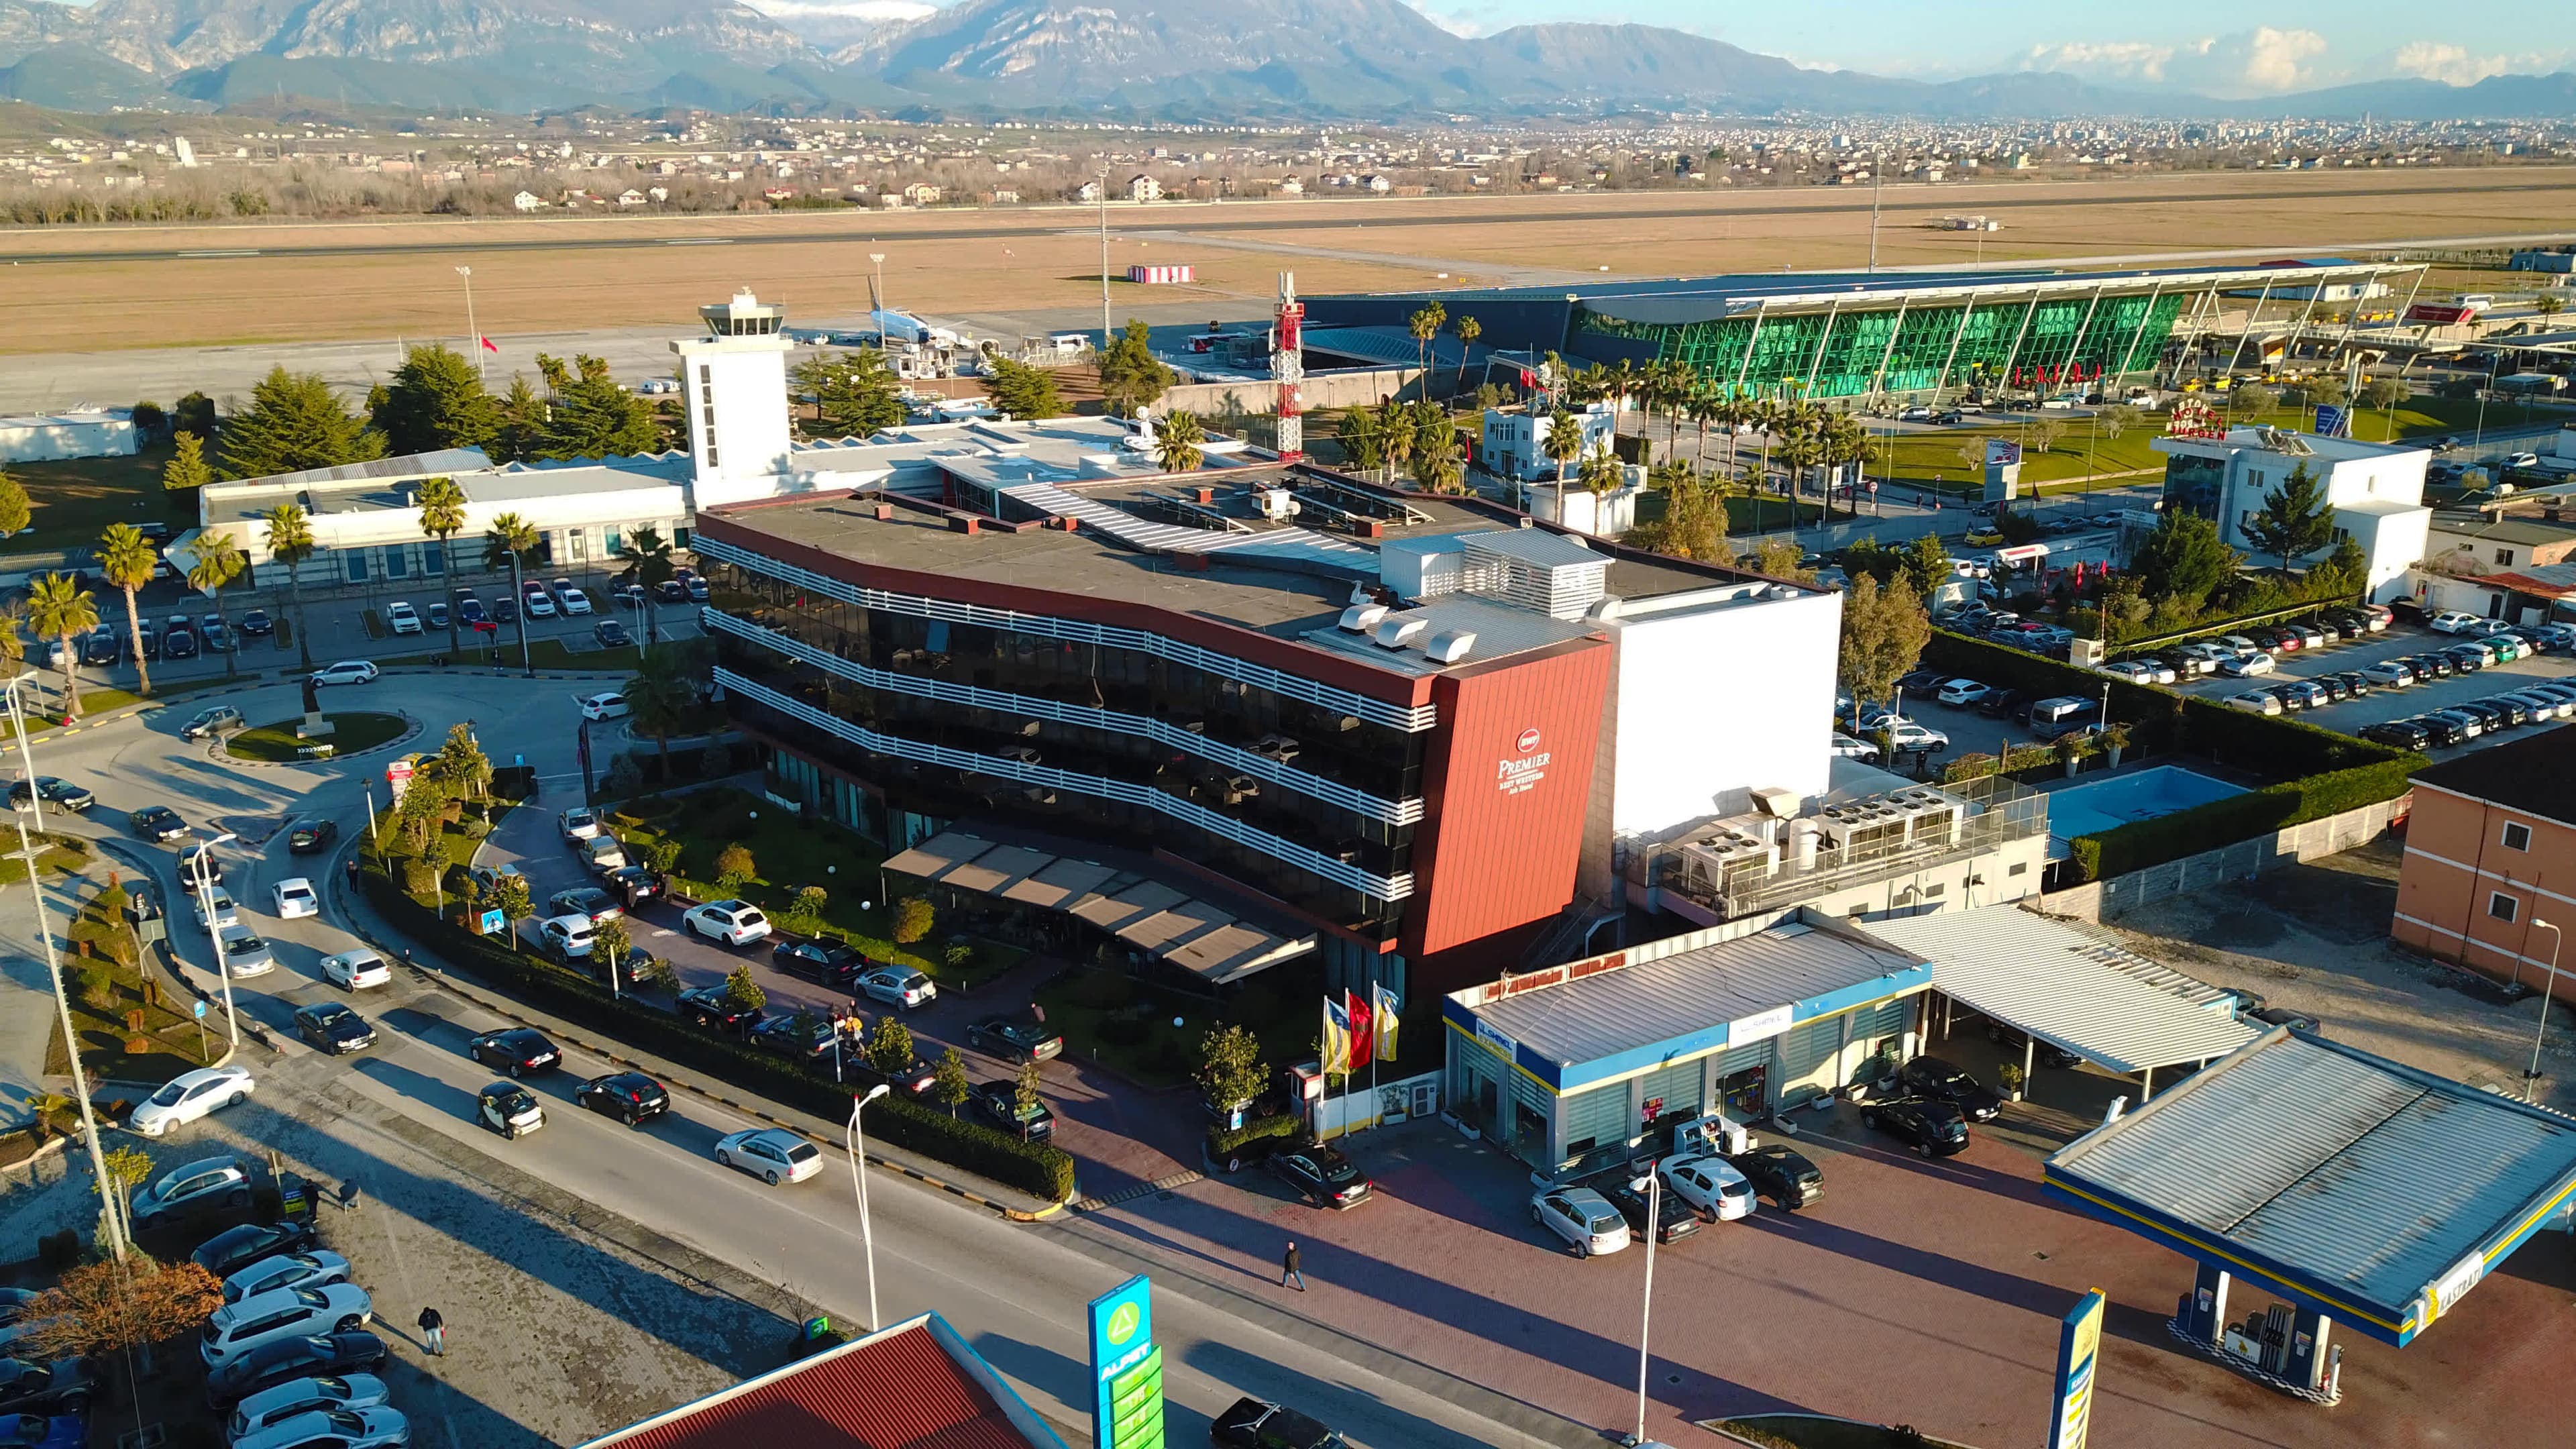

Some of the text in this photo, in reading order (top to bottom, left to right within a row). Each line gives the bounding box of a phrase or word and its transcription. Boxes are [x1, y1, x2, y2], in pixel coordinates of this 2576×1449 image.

[2174, 407, 2223, 428] HOTEL
[2170, 427, 2226, 441] JURGEN
[1497, 752, 1550, 780] PREMIER
[2439, 1266, 2482, 1311] KASTRATI
[1100, 1342, 1150, 1382] ALPET
